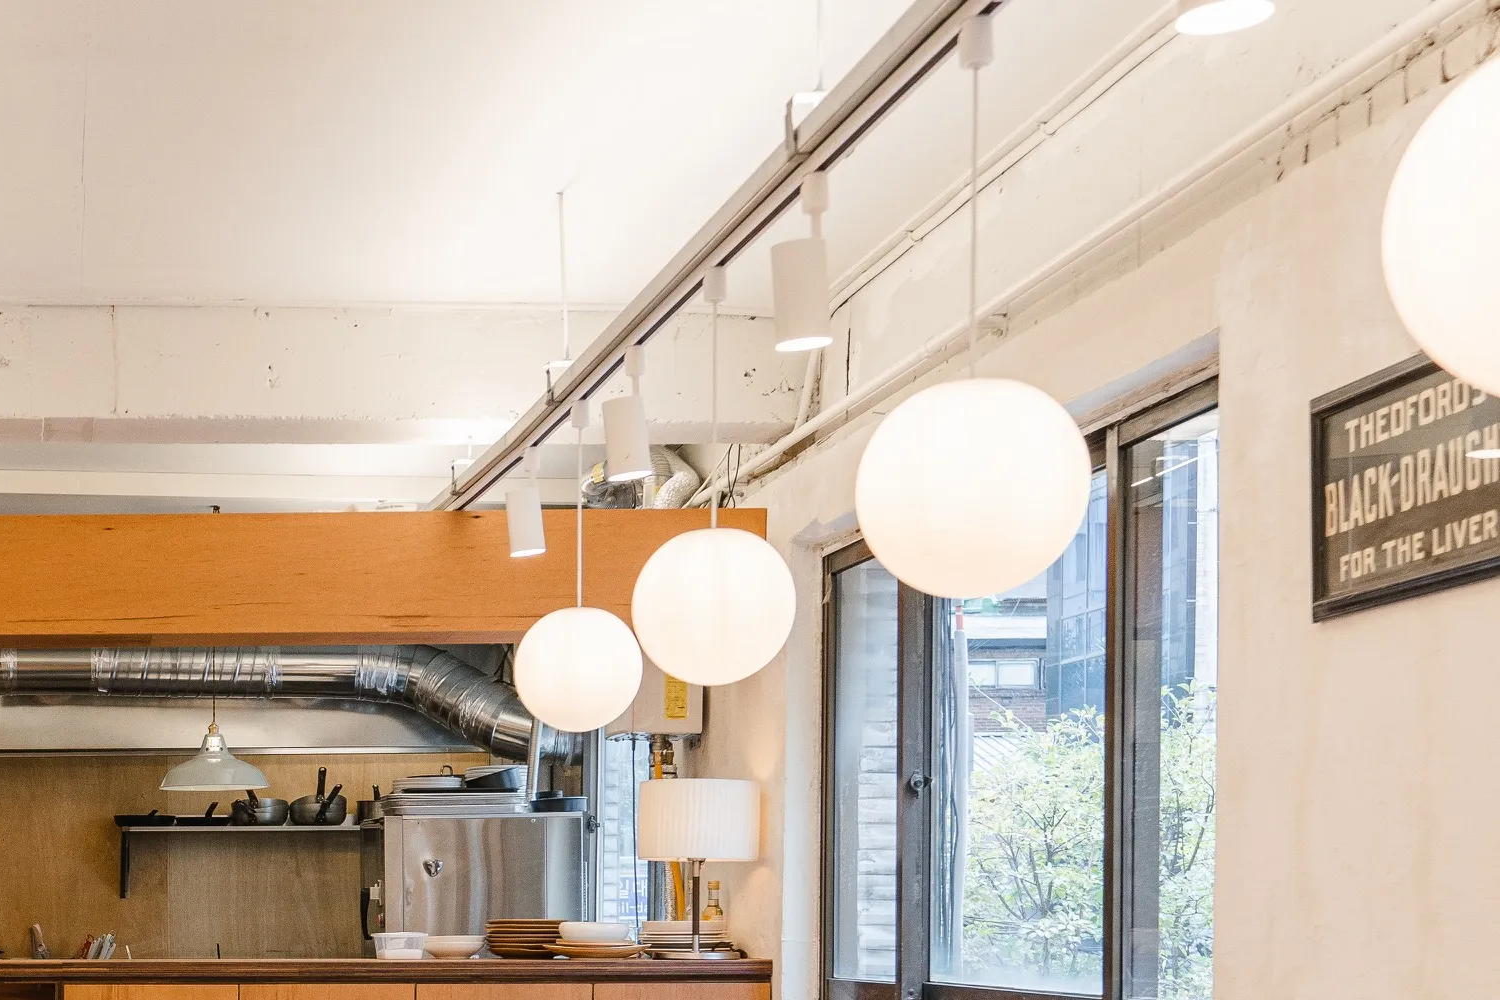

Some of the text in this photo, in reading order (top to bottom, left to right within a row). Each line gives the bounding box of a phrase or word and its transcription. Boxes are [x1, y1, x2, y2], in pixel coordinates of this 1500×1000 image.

[1325, 422, 1500, 537] BLACK-DRAUGH
[1340, 509, 1498, 582] FOR THE LIVER
